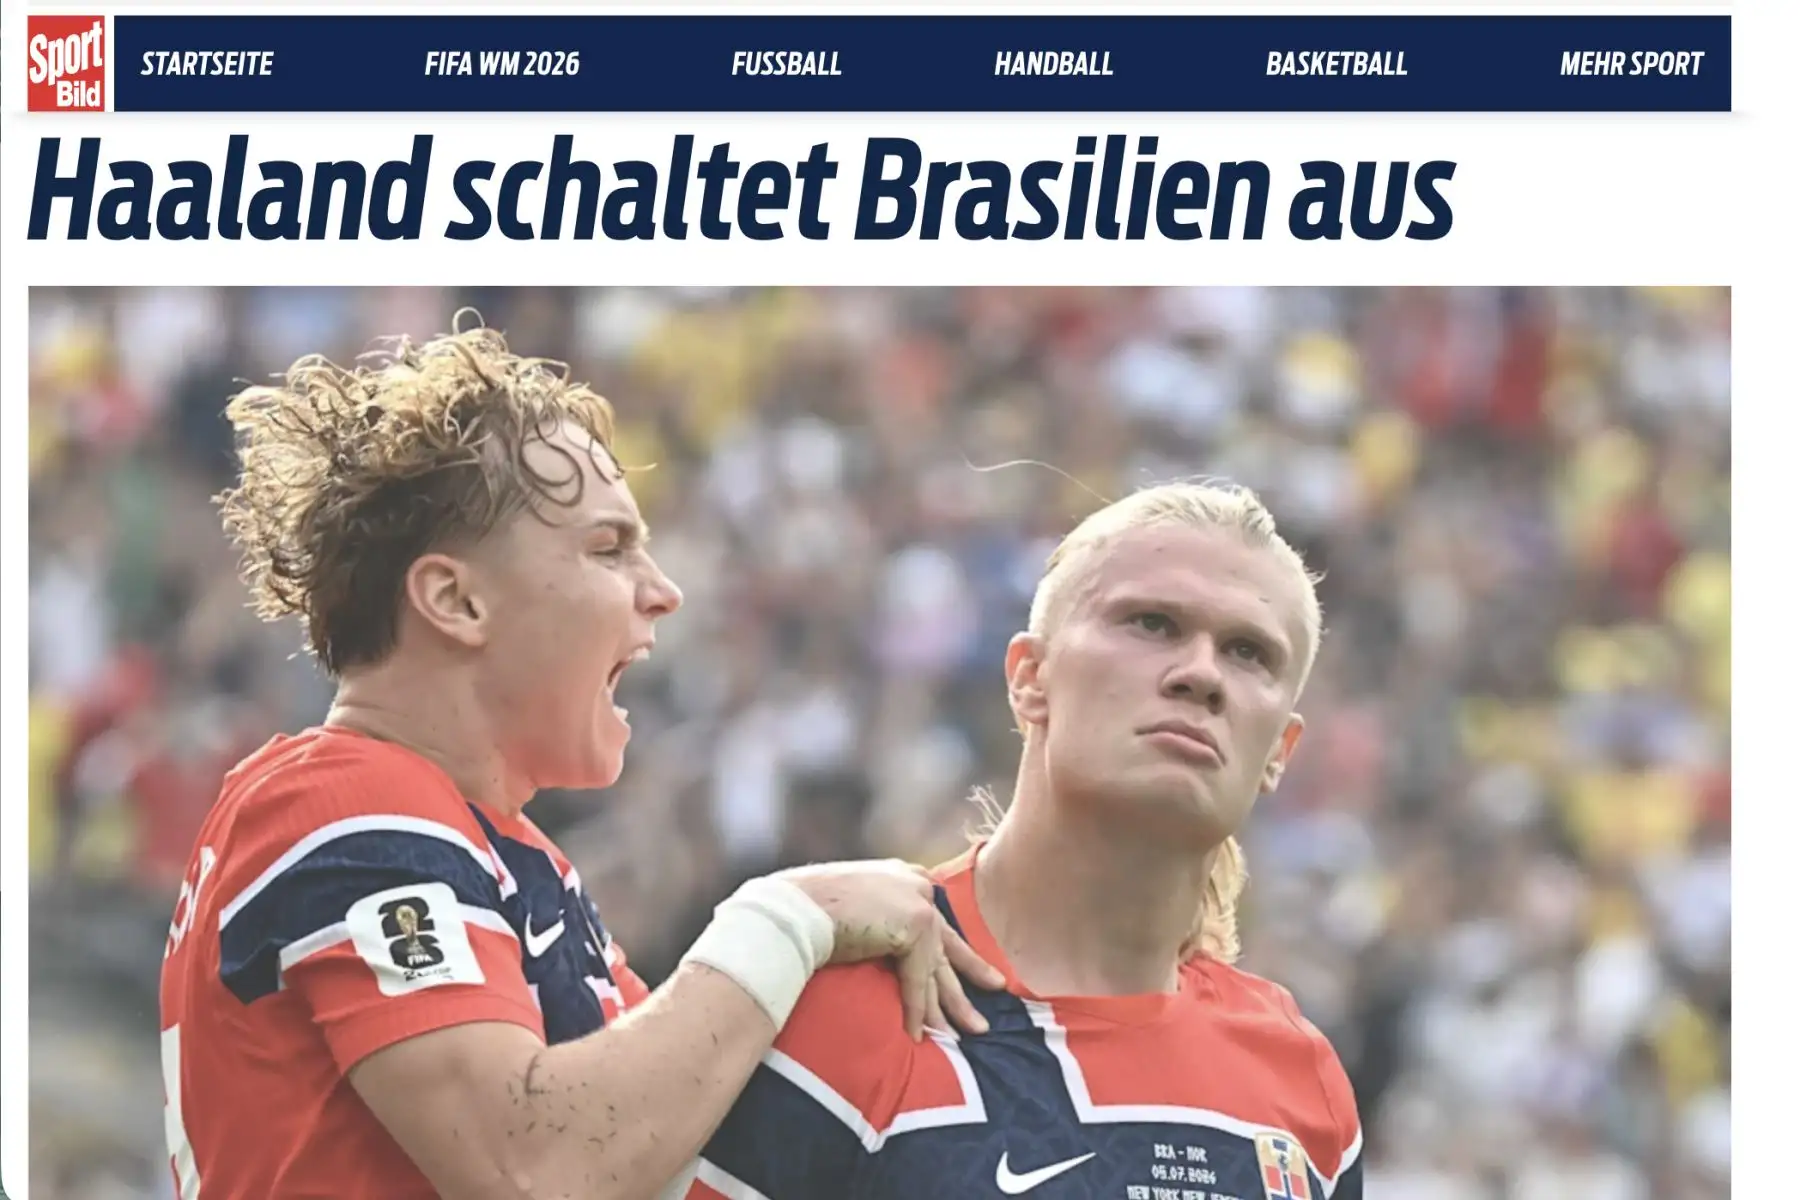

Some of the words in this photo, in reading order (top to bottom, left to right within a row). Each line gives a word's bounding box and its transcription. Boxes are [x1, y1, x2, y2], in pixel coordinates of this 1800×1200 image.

[29, 20, 103, 86] Sport
[140, 51, 275, 76] STARTSEITE
[424, 51, 473, 76] FIFA
[479, 51, 521, 76] WM
[523, 50, 580, 76] 2026
[731, 51, 842, 76] FUSSBALL
[994, 51, 1114, 76] HANDBALL
[1266, 51, 1408, 76] BASKETBALL
[1560, 51, 1626, 76] MEHR
[1629, 51, 1706, 76] SPORT
[56, 79, 101, 107] Bild
[26, 134, 434, 241] Haaland
[444, 134, 839, 241] schaltet
[853, 134, 1271, 241] Brasilien
[1288, 160, 1458, 241] aus
[407, 954, 434, 966] FIFA
